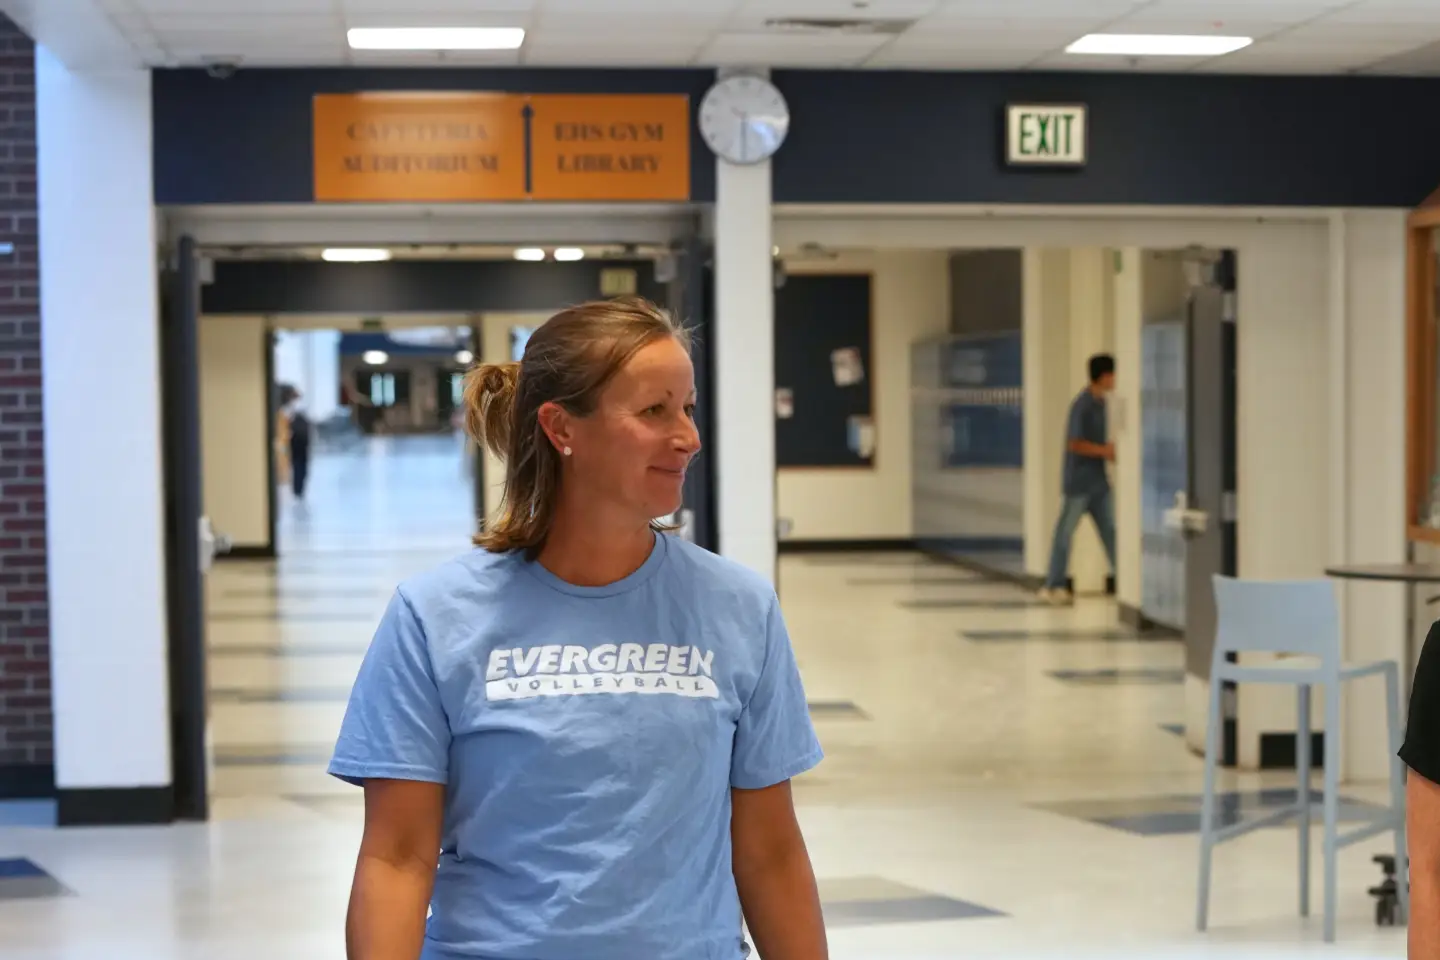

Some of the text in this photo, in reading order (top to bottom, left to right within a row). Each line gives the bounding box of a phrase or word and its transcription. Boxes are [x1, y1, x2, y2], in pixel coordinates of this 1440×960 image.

[554, 121, 664, 141] EHS GYM
[1019, 113, 1076, 155] EXIT
[340, 153, 499, 173] AUDITORIUM
[557, 153, 660, 173] LIBRARY
[486, 643, 714, 681] EVERGREEN
[507, 675, 705, 693] VOLLEYBALL
